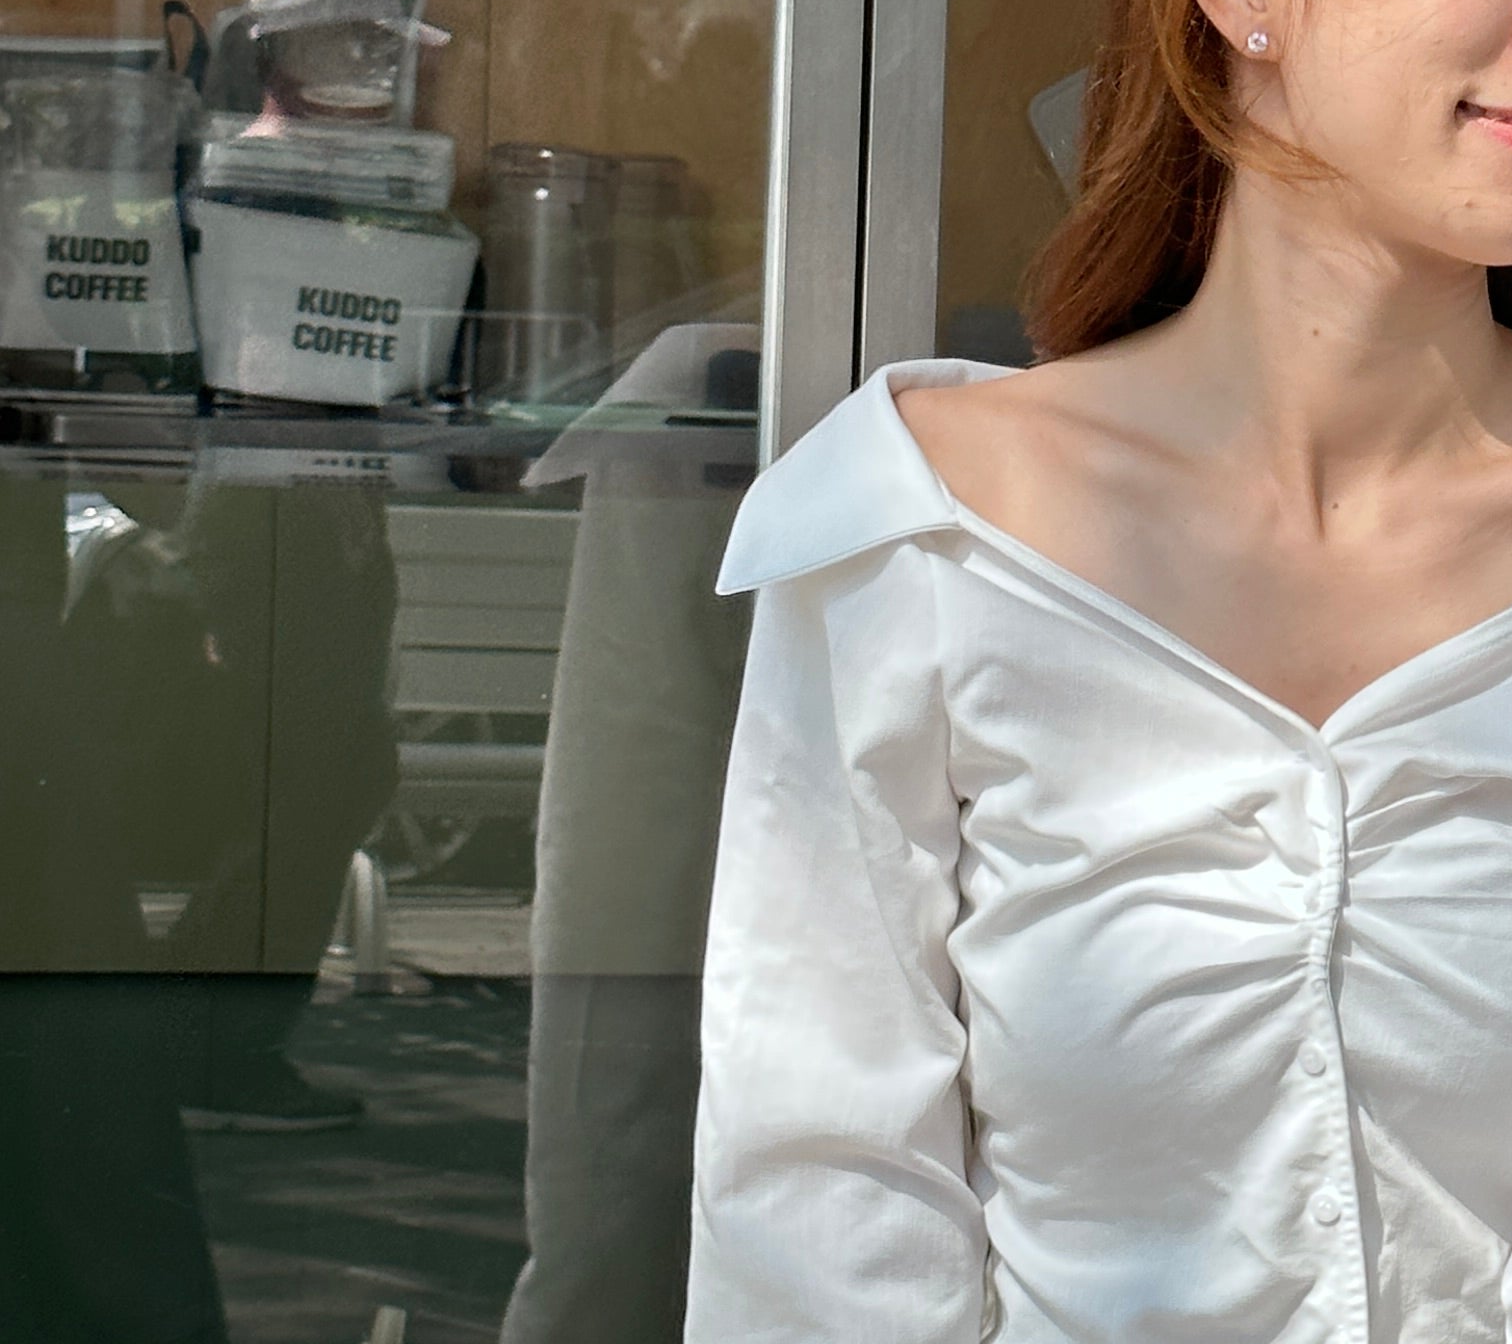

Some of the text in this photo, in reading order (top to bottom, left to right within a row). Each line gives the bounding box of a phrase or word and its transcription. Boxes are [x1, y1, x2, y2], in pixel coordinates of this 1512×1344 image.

[47, 235, 151, 266] KUDDO
[46, 272, 149, 302] COFFEE
[297, 286, 402, 325] KUDDO
[293, 323, 398, 362] COFFEE
